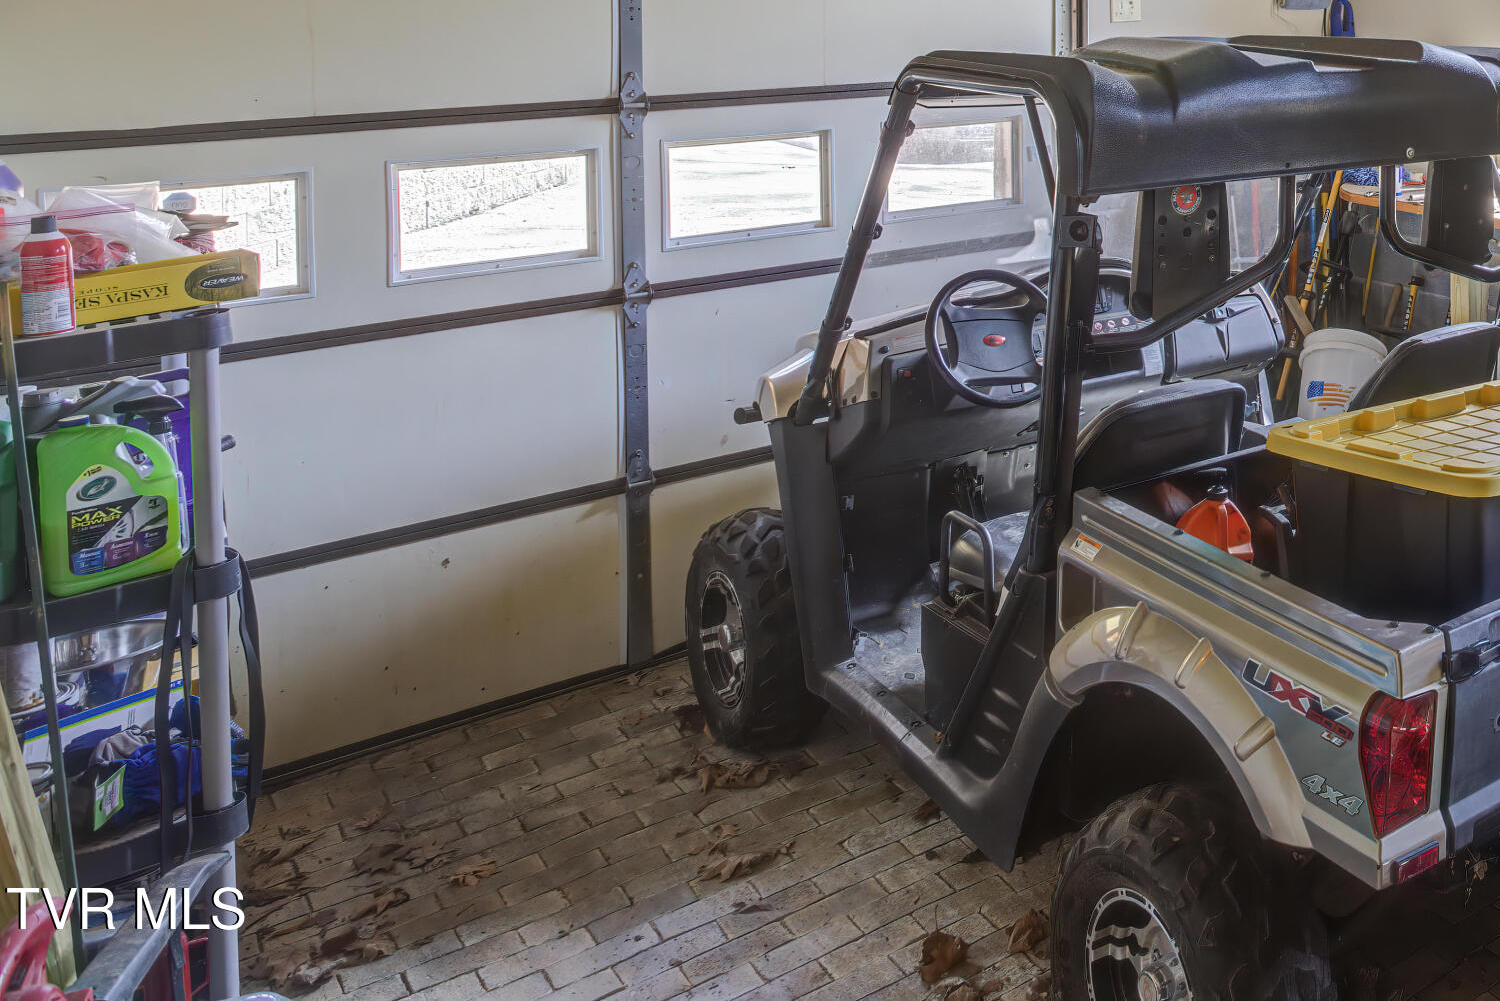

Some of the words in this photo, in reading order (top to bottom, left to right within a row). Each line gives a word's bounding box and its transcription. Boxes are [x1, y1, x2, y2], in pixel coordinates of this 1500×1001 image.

[201, 274, 244, 288] WEAVER
[105, 286, 168, 305] KASPA
[72, 505, 124, 523] MAX
[72, 513, 121, 529] POWER
[1241, 657, 1353, 723] UXV
